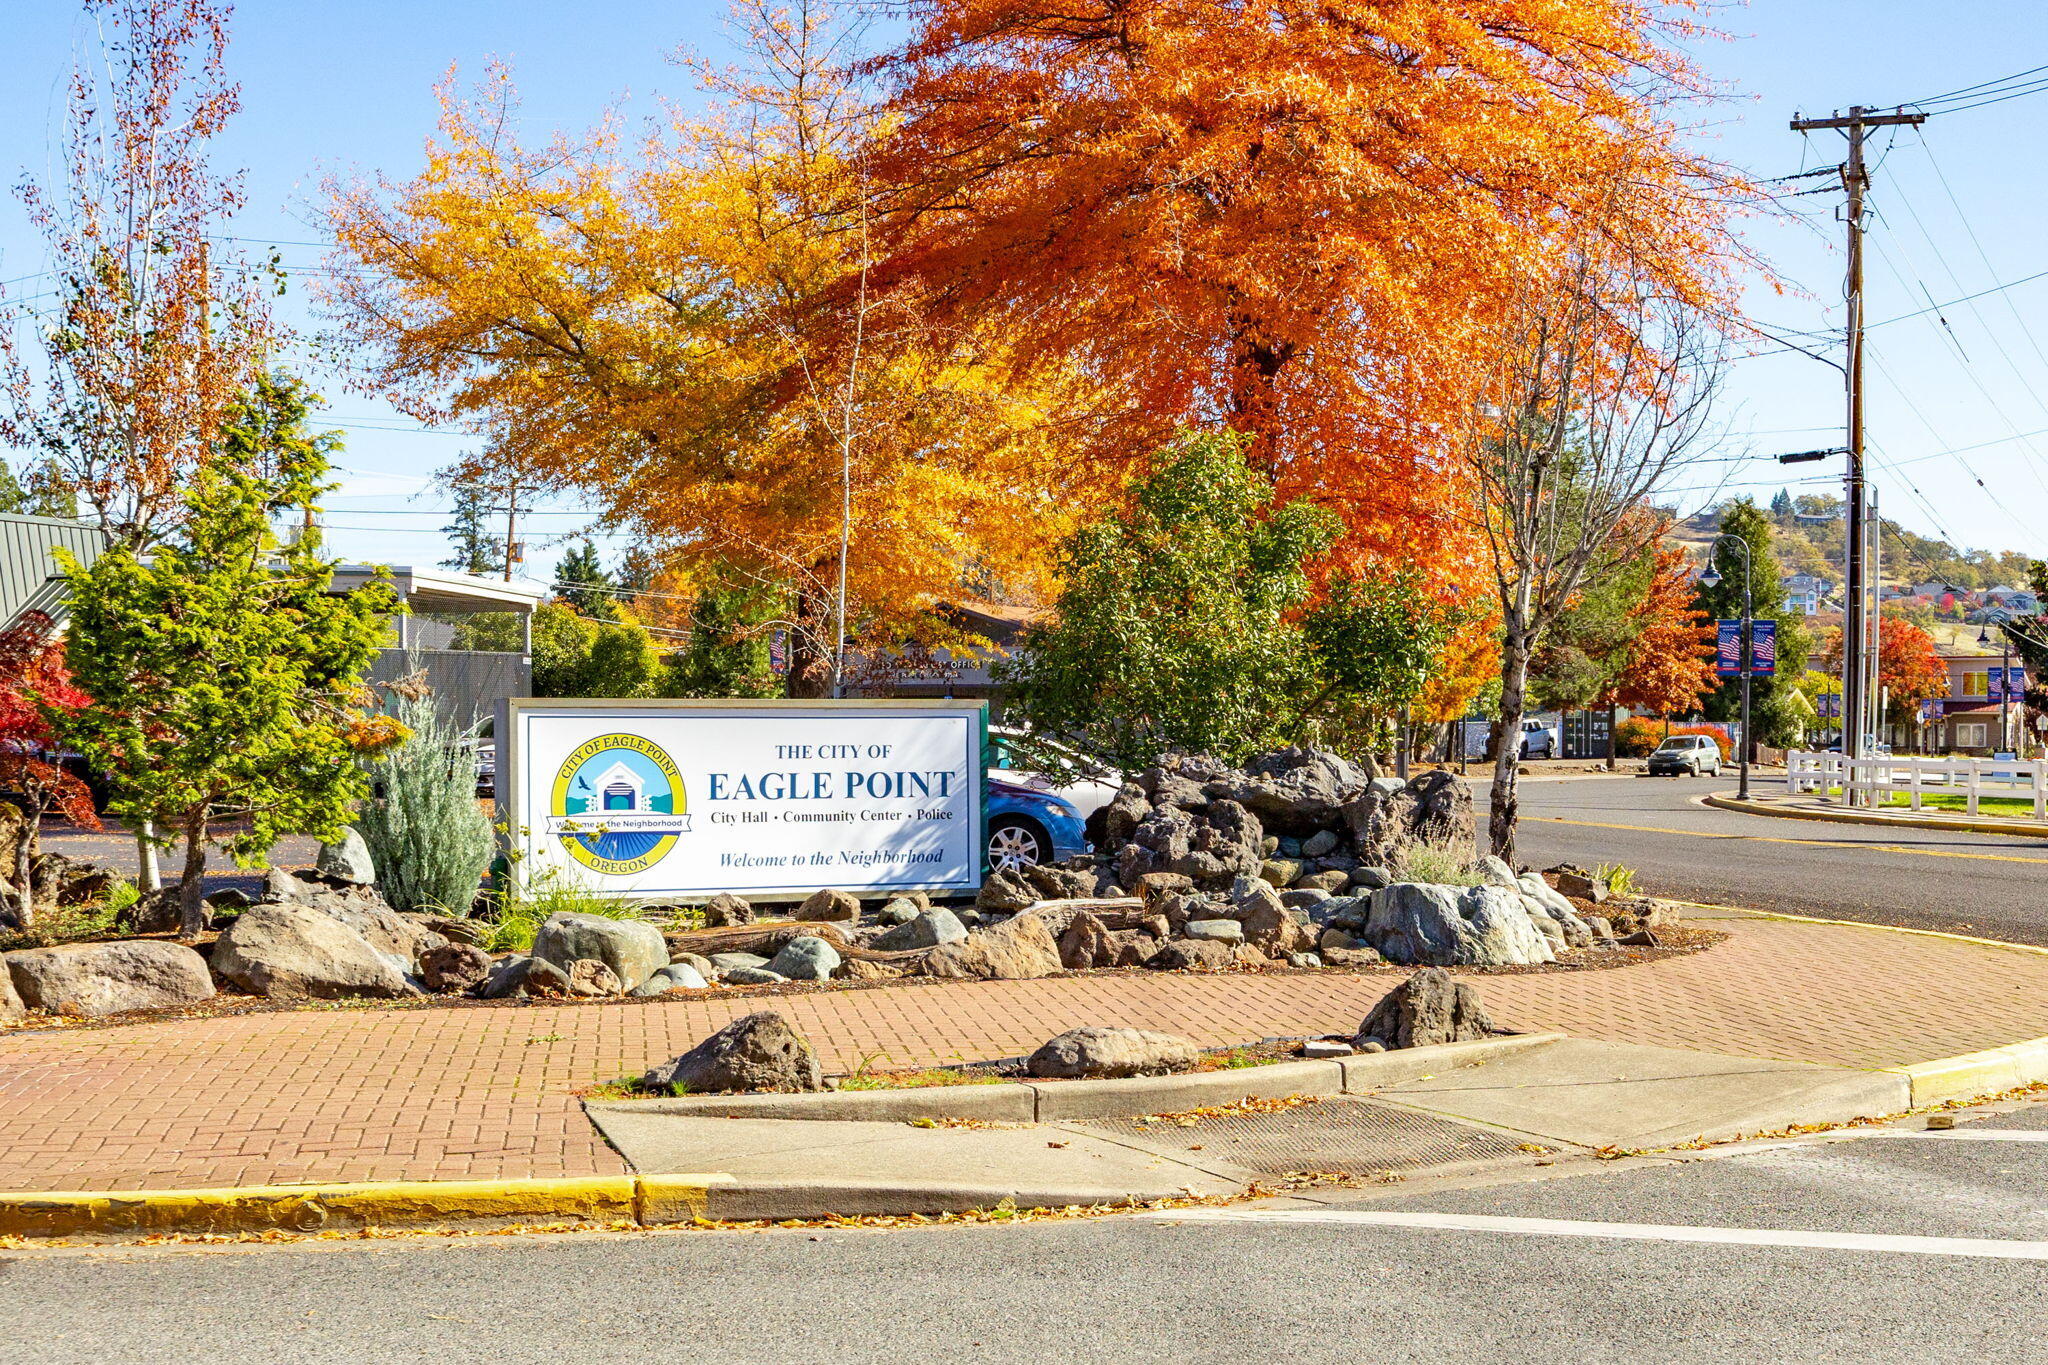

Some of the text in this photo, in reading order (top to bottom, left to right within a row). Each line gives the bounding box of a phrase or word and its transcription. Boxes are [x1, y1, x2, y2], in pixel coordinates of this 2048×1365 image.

[561, 736, 678, 779] CITY OF EAGLE POINT
[775, 744, 892, 759] THE CITY OF
[707, 771, 956, 801] EAGLE POINT
[606, 820, 621, 828] the
[623, 819, 683, 829] Neighborhood
[710, 808, 953, 827] City Hall Community Center Police
[590, 857, 648, 873] OREGON
[720, 848, 944, 868] Welcome to the Neighborhood
